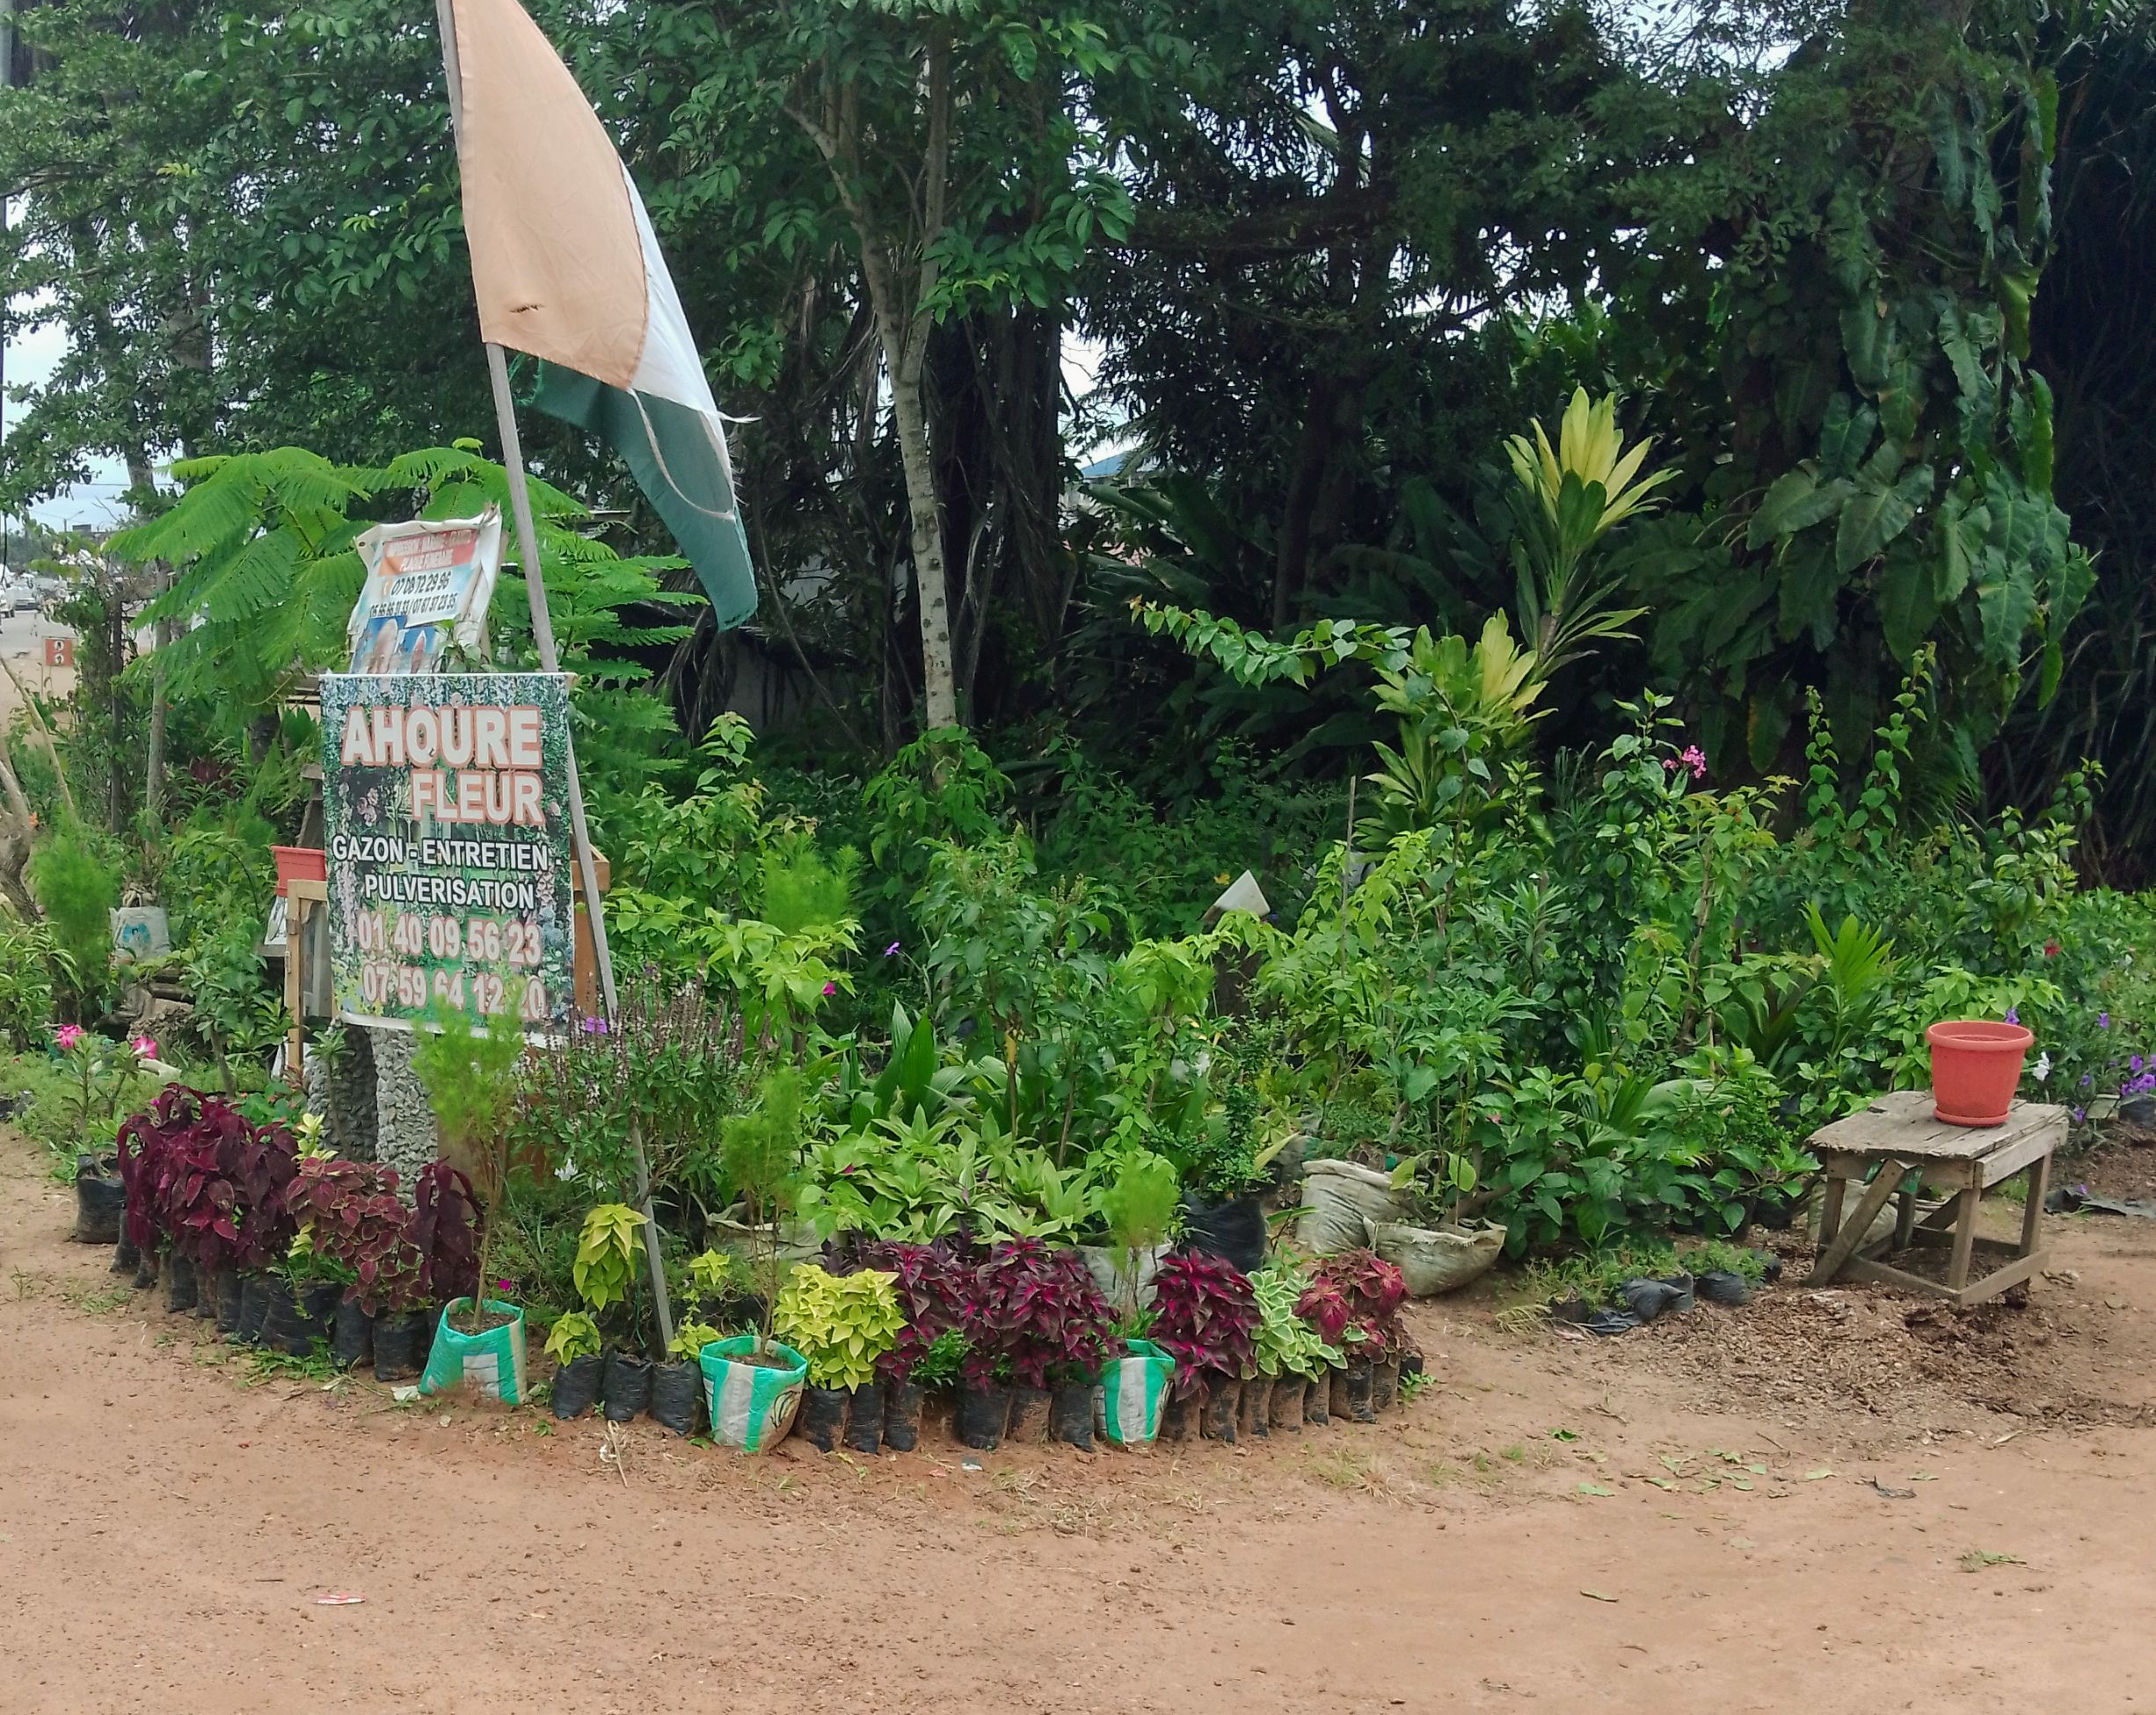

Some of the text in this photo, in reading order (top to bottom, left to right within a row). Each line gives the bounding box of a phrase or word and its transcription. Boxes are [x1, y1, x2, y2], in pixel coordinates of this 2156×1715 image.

[391, 578, 404, 596] 07
[415, 575, 426, 594] 72
[425, 573, 439, 592] 29
[341, 705, 543, 769] AHOURE
[411, 770, 545, 825] FLEUR
[332, 835, 404, 863] GAZON
[421, 838, 549, 871] ENTRETIEN
[364, 873, 535, 911] PULVERISATION
[357, 912, 543, 964] 01 40 09 56 23
[362, 963, 390, 1004] 07
[397, 965, 427, 1008] 59
[473, 972, 504, 1015] 12
